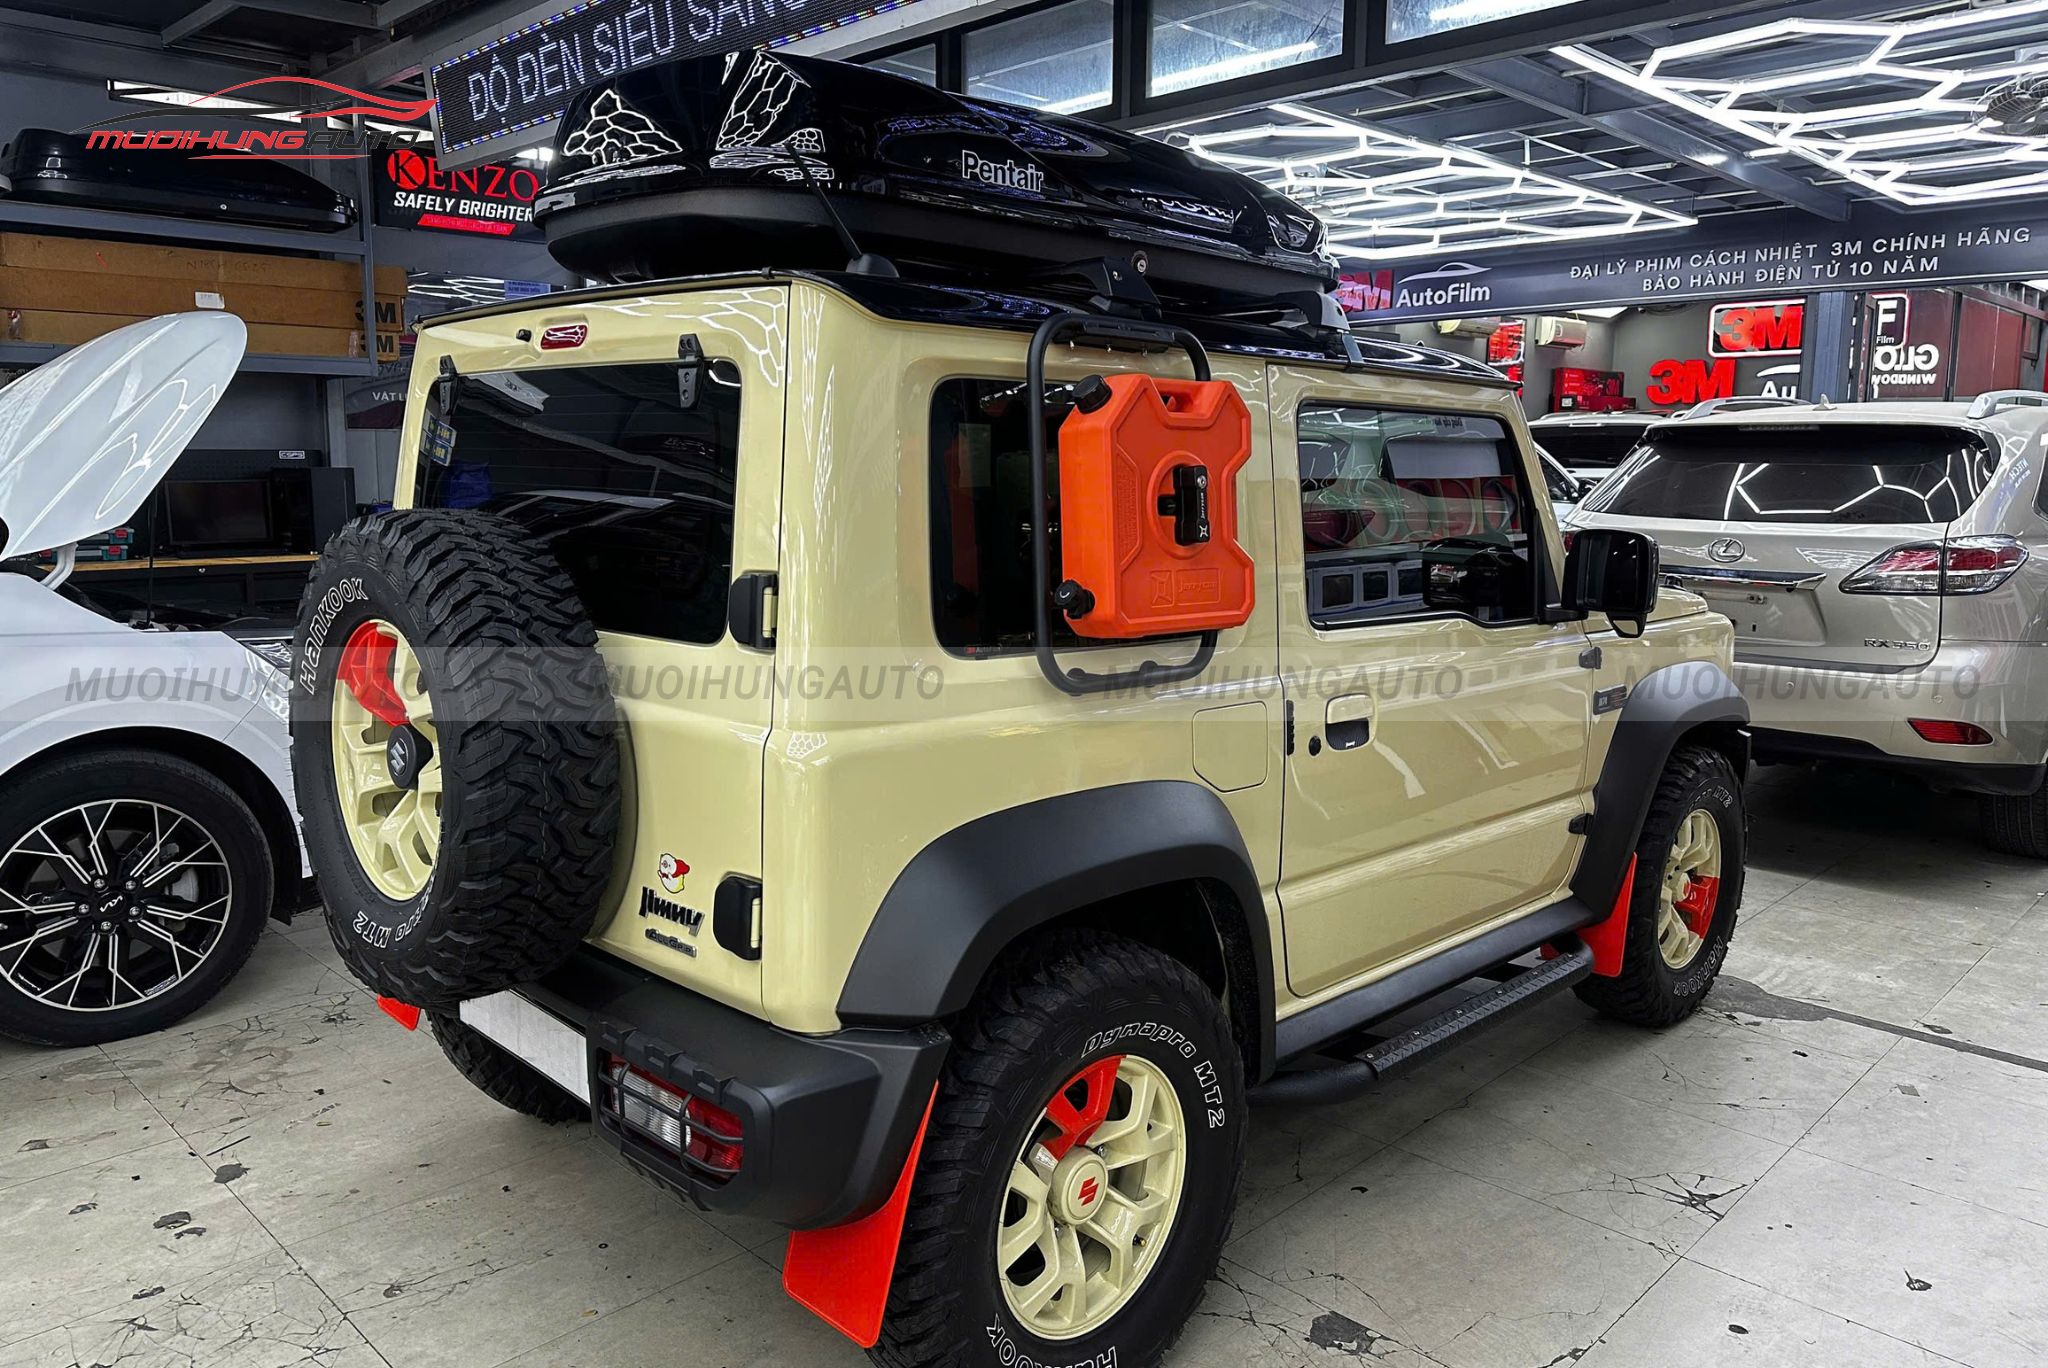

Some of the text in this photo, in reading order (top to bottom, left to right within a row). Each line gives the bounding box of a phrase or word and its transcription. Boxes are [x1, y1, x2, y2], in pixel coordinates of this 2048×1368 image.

[517, 33, 586, 104] ĐÈN
[388, 149, 539, 203] KENZO
[961, 149, 1044, 192] Pentair
[394, 191, 532, 223] SAFELY BRIGHTER
[1570, 227, 2031, 280] ĐẠI LÝ PHIM CÁCH NHIỆT 3M CHÍNH HÃNG
[1643, 254, 1939, 292] BẢO HÀNH ĐIỆN TỬ 10 NĂM
[1396, 283, 1491, 308] AutoFilm
[1719, 305, 1803, 351] 3M
[1646, 359, 1735, 405] 3M
[1864, 638, 1931, 651] RX 350
[639, 886, 705, 937] Jimny
[1081, 1022, 1226, 1128] Dynapro MT2
